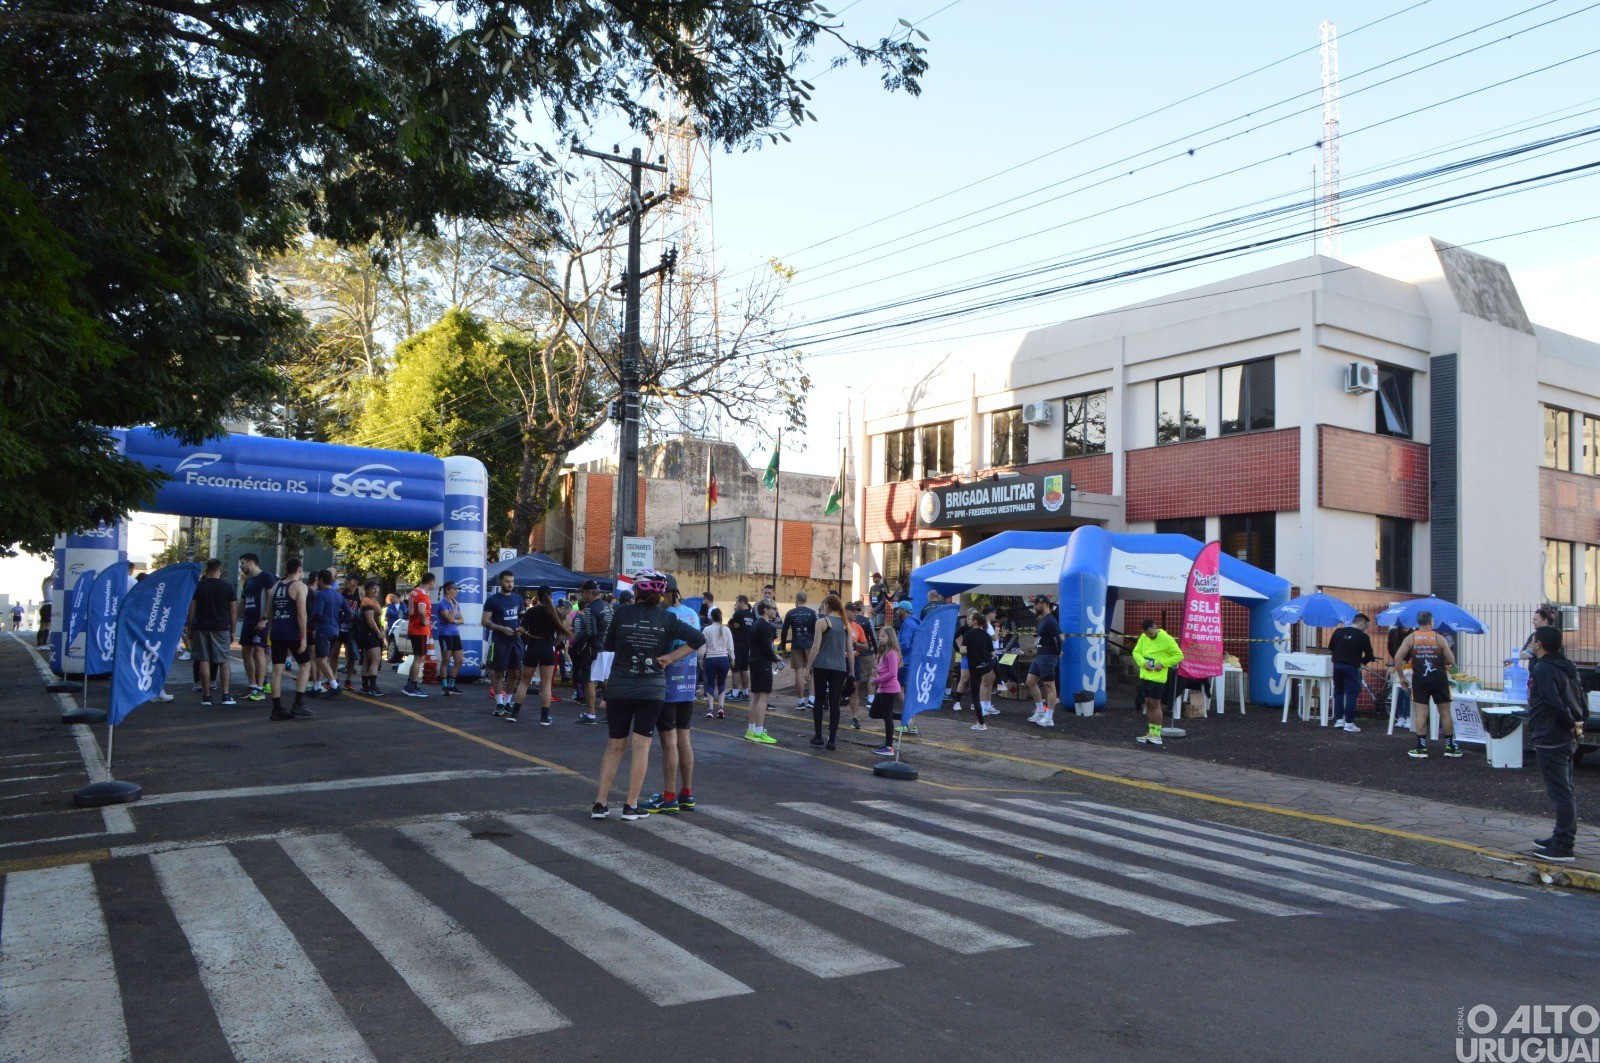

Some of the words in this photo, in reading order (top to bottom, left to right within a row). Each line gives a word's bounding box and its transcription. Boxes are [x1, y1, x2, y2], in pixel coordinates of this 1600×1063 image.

[186, 471, 282, 492] Fecomércio
[287, 480, 308, 494] RS
[330, 470, 402, 500] Sesc
[945, 488, 989, 508] BRIGADA
[991, 482, 1035, 503] MILITAR
[450, 508, 480, 521] Sesc
[954, 509, 965, 518] BPM
[968, 506, 997, 516] FREDERICO
[998, 502, 1035, 514] WESTPHALEN
[145, 582, 166, 632] Fecomércio
[505, 608, 518, 616] 176
[157, 606, 171, 633] Senac
[1186, 623, 1199, 632] DE
[926, 619, 940, 657] Fecomércio
[935, 638, 943, 658] Senac
[1191, 633, 1221, 642] SORVETE
[1083, 606, 1106, 693] Sesc
[137, 640, 162, 691] Sesc
[917, 663, 937, 704] Sesc
[1455, 708, 1481, 723] Barril
[1460, 703, 1471, 712] Do
